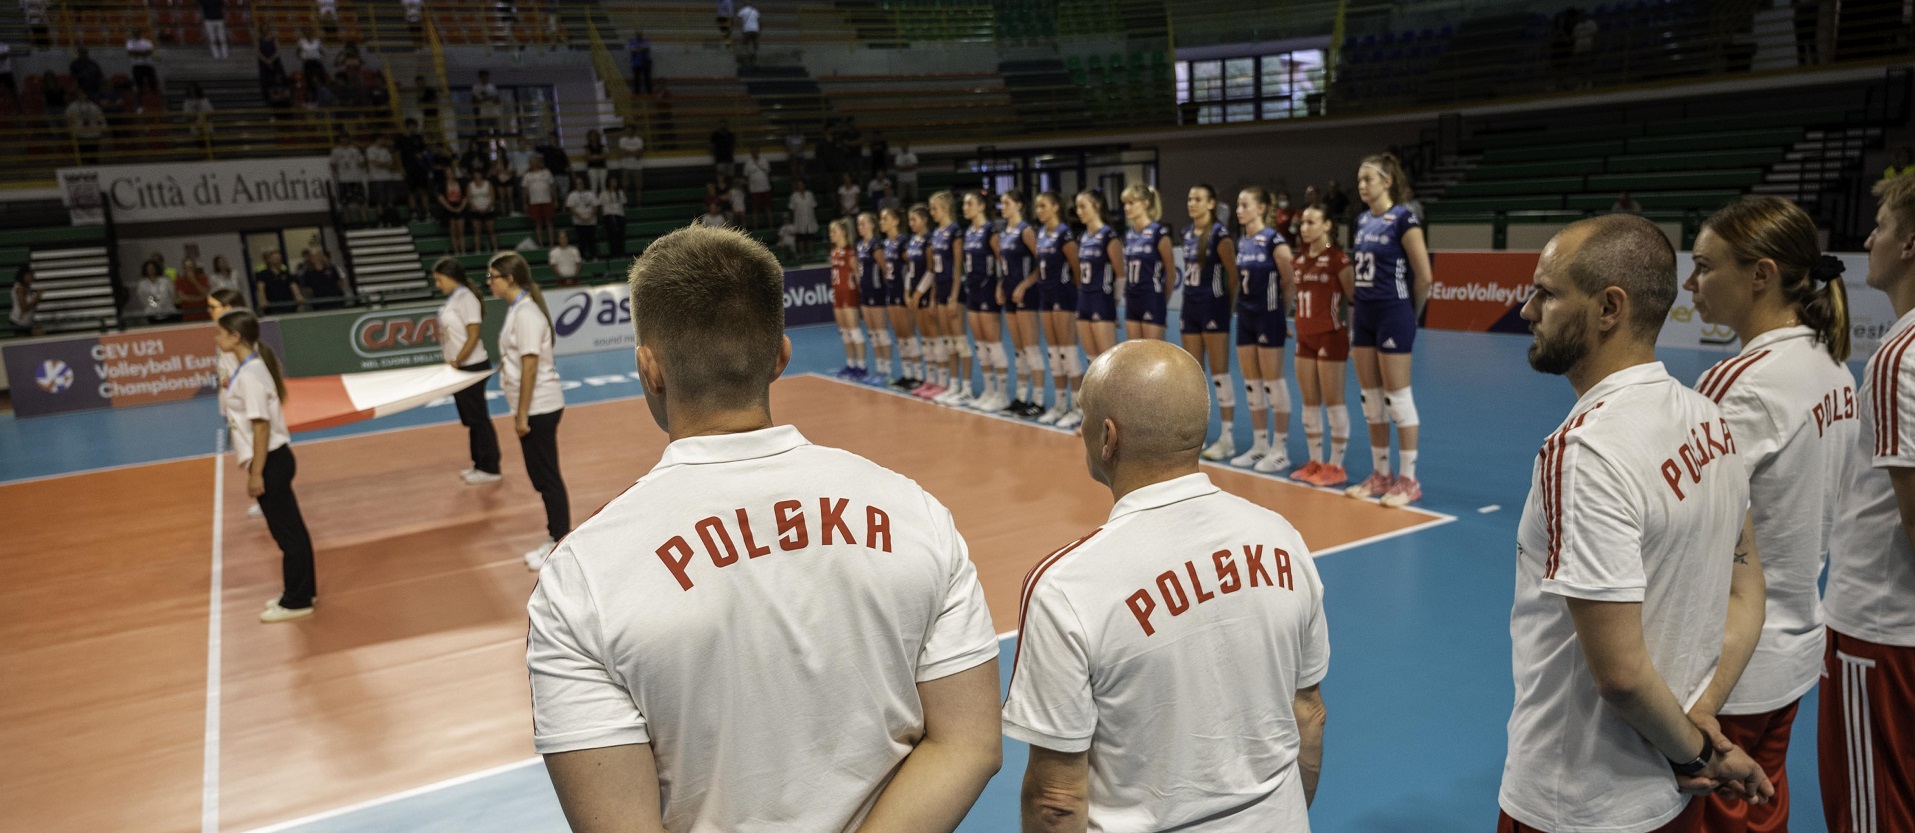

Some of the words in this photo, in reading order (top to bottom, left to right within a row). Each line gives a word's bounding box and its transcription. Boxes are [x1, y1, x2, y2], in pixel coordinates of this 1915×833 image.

[110, 174, 186, 212] Città
[193, 173, 223, 206] di
[231, 169, 327, 205] Andria
[1355, 252, 1376, 281] 23
[1240, 270, 1249, 294] 7
[1298, 290, 1312, 318] 11
[91, 342, 129, 360] CEV
[132, 340, 164, 356] U21
[94, 355, 182, 379] Volleyball
[184, 355, 218, 370] Eur
[1812, 386, 1860, 439] POLS
[655, 496, 893, 592] POLSKA
[1125, 544, 1294, 638] POLSKA
